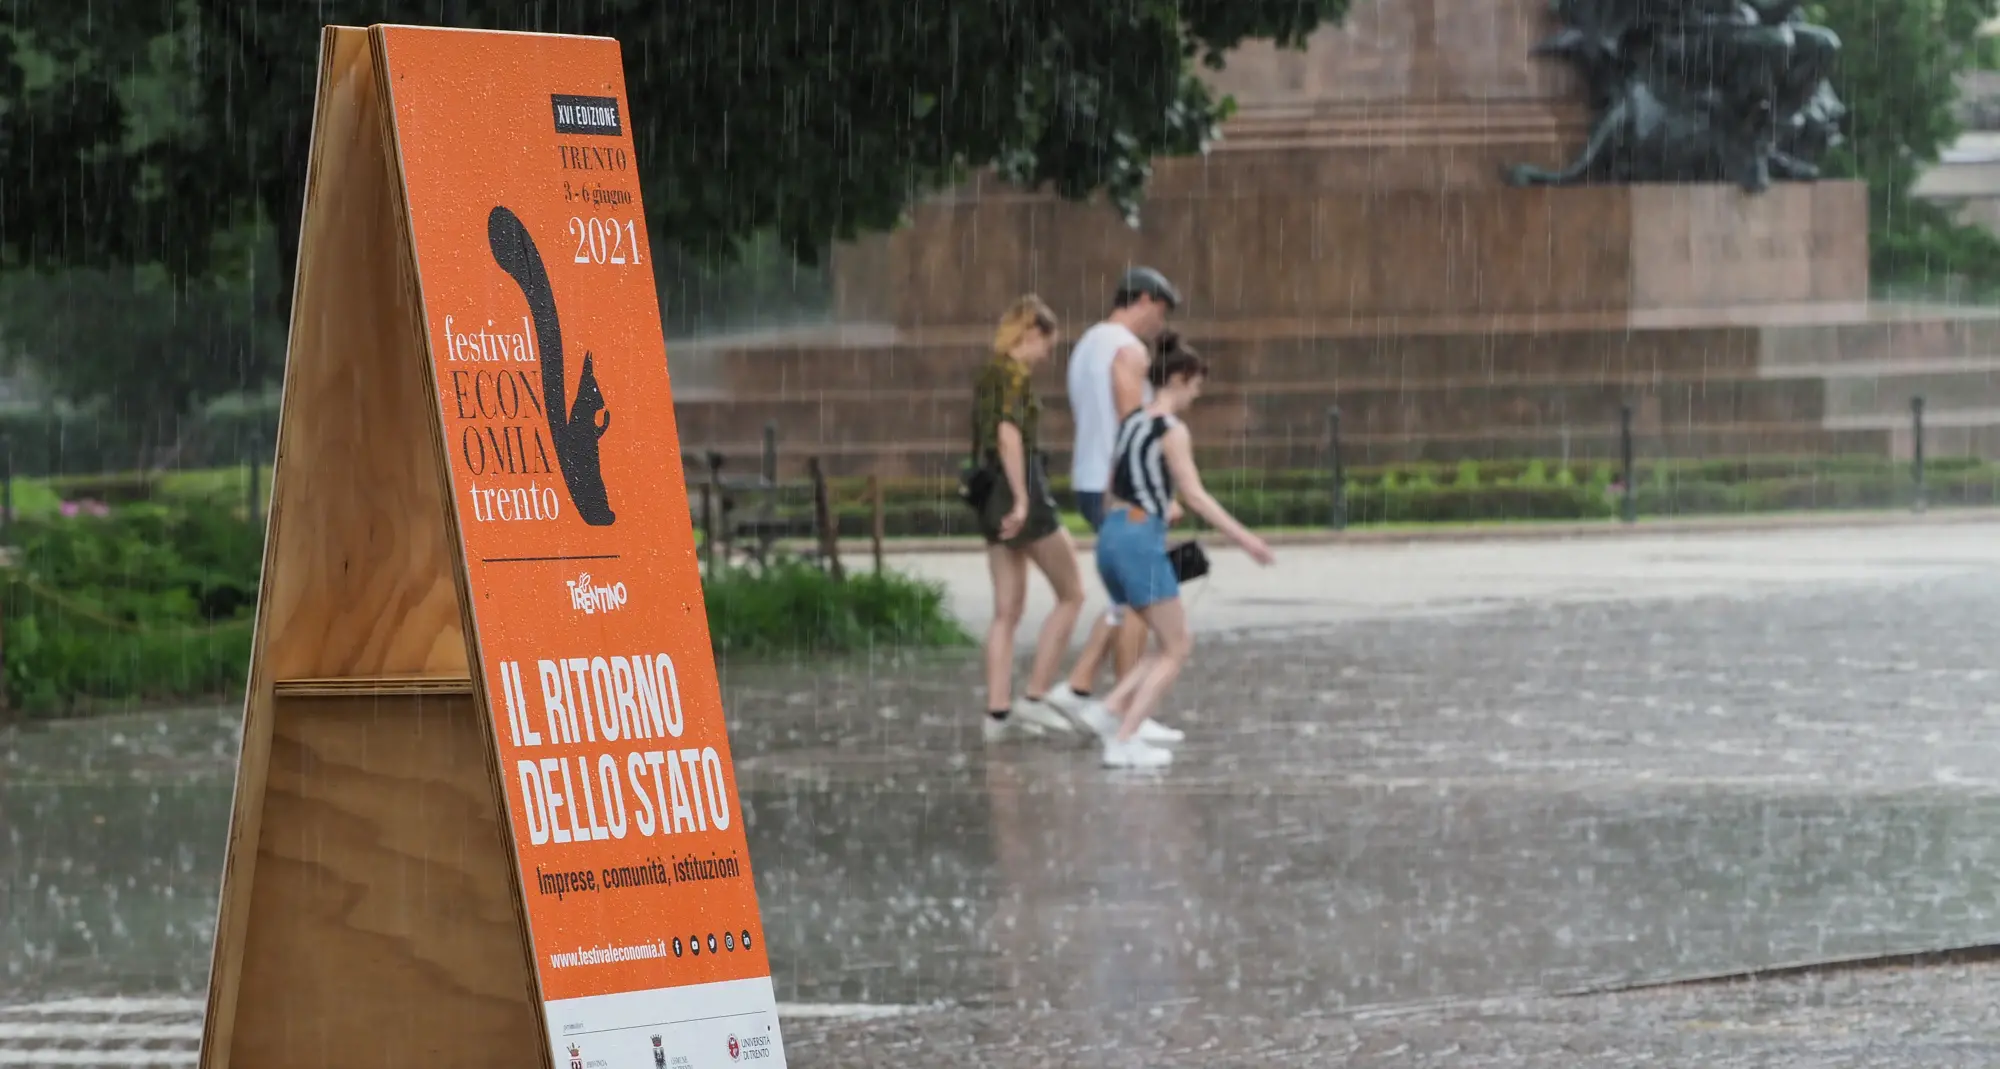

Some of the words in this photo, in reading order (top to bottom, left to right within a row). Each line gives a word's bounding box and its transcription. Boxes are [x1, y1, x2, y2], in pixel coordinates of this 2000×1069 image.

[557, 104, 574, 126] XVI
[576, 105, 617, 127] EDIZIONE
[558, 145, 627, 171] TRENTO
[592, 183, 632, 210] giugno
[569, 216, 641, 265] 2021
[444, 314, 536, 362] festival
[451, 369, 543, 419] ECON
[463, 426, 553, 475] OMIA
[470, 480, 559, 522] trento
[500, 661, 542, 747] IL
[538, 653, 684, 745] RITORNO
[517, 754, 627, 846] DELLO
[627, 746, 730, 837] STATO
[536, 865, 600, 901] Imprese,
[602, 857, 671, 888] comunità,
[672, 850, 740, 882] istituzioni
[550, 938, 667, 969] www.festivaleconomia.it
